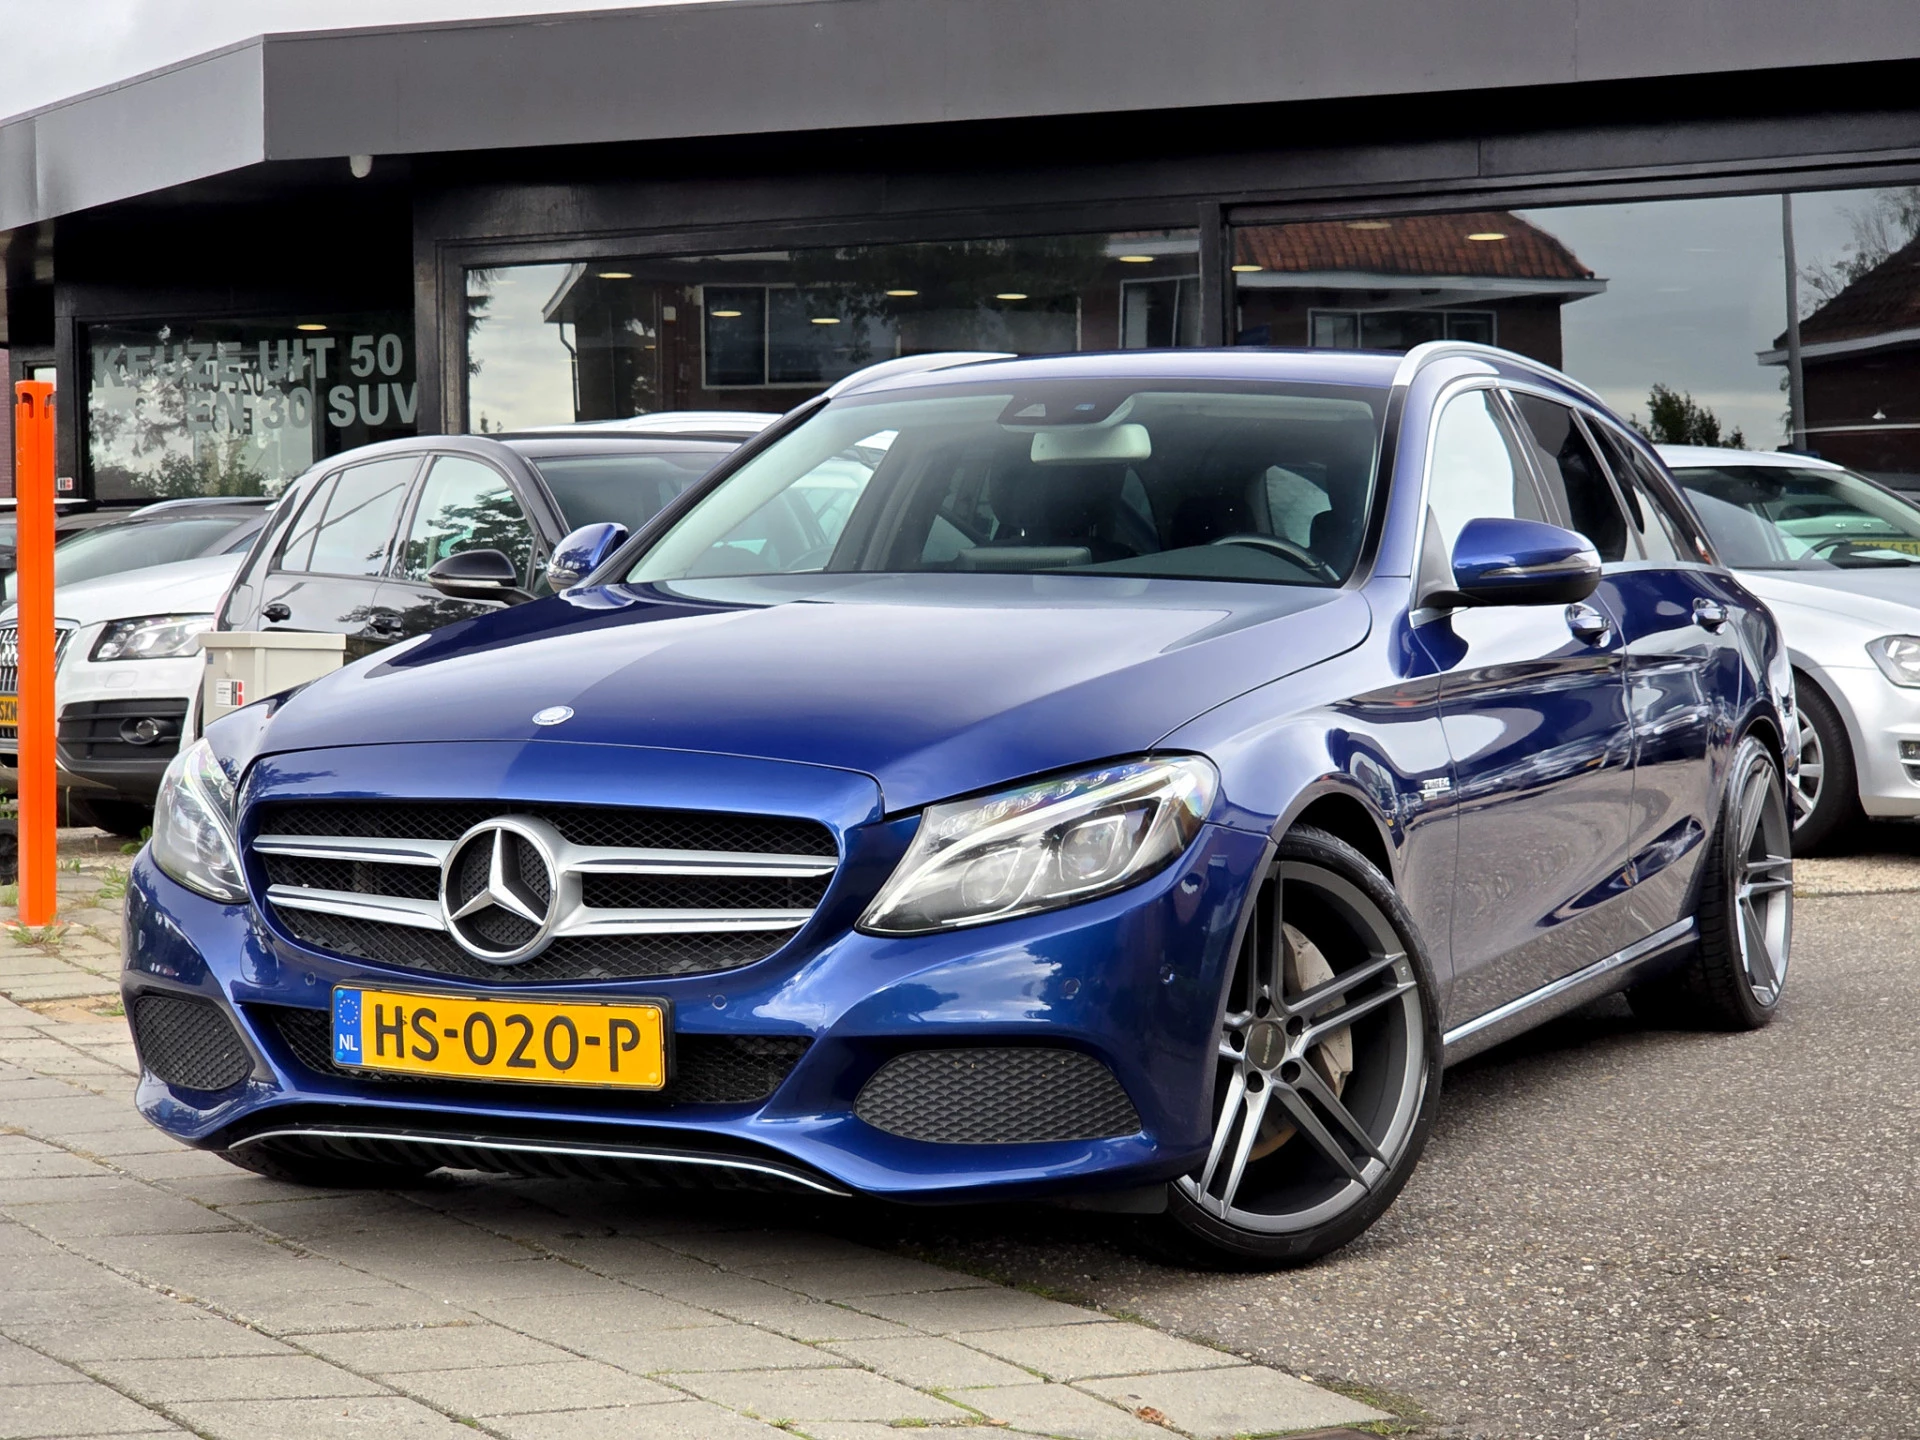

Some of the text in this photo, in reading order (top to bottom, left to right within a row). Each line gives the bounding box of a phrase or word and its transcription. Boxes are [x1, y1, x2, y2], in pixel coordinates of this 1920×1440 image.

[94, 341, 242, 388] KEUZE
[259, 337, 336, 381] UIT
[350, 333, 403, 378] 50
[187, 390, 245, 432] EN
[262, 386, 313, 430] 30
[328, 382, 418, 428] SUV
[338, 1033, 359, 1052] NL
[374, 1003, 641, 1073] HS-020-P
